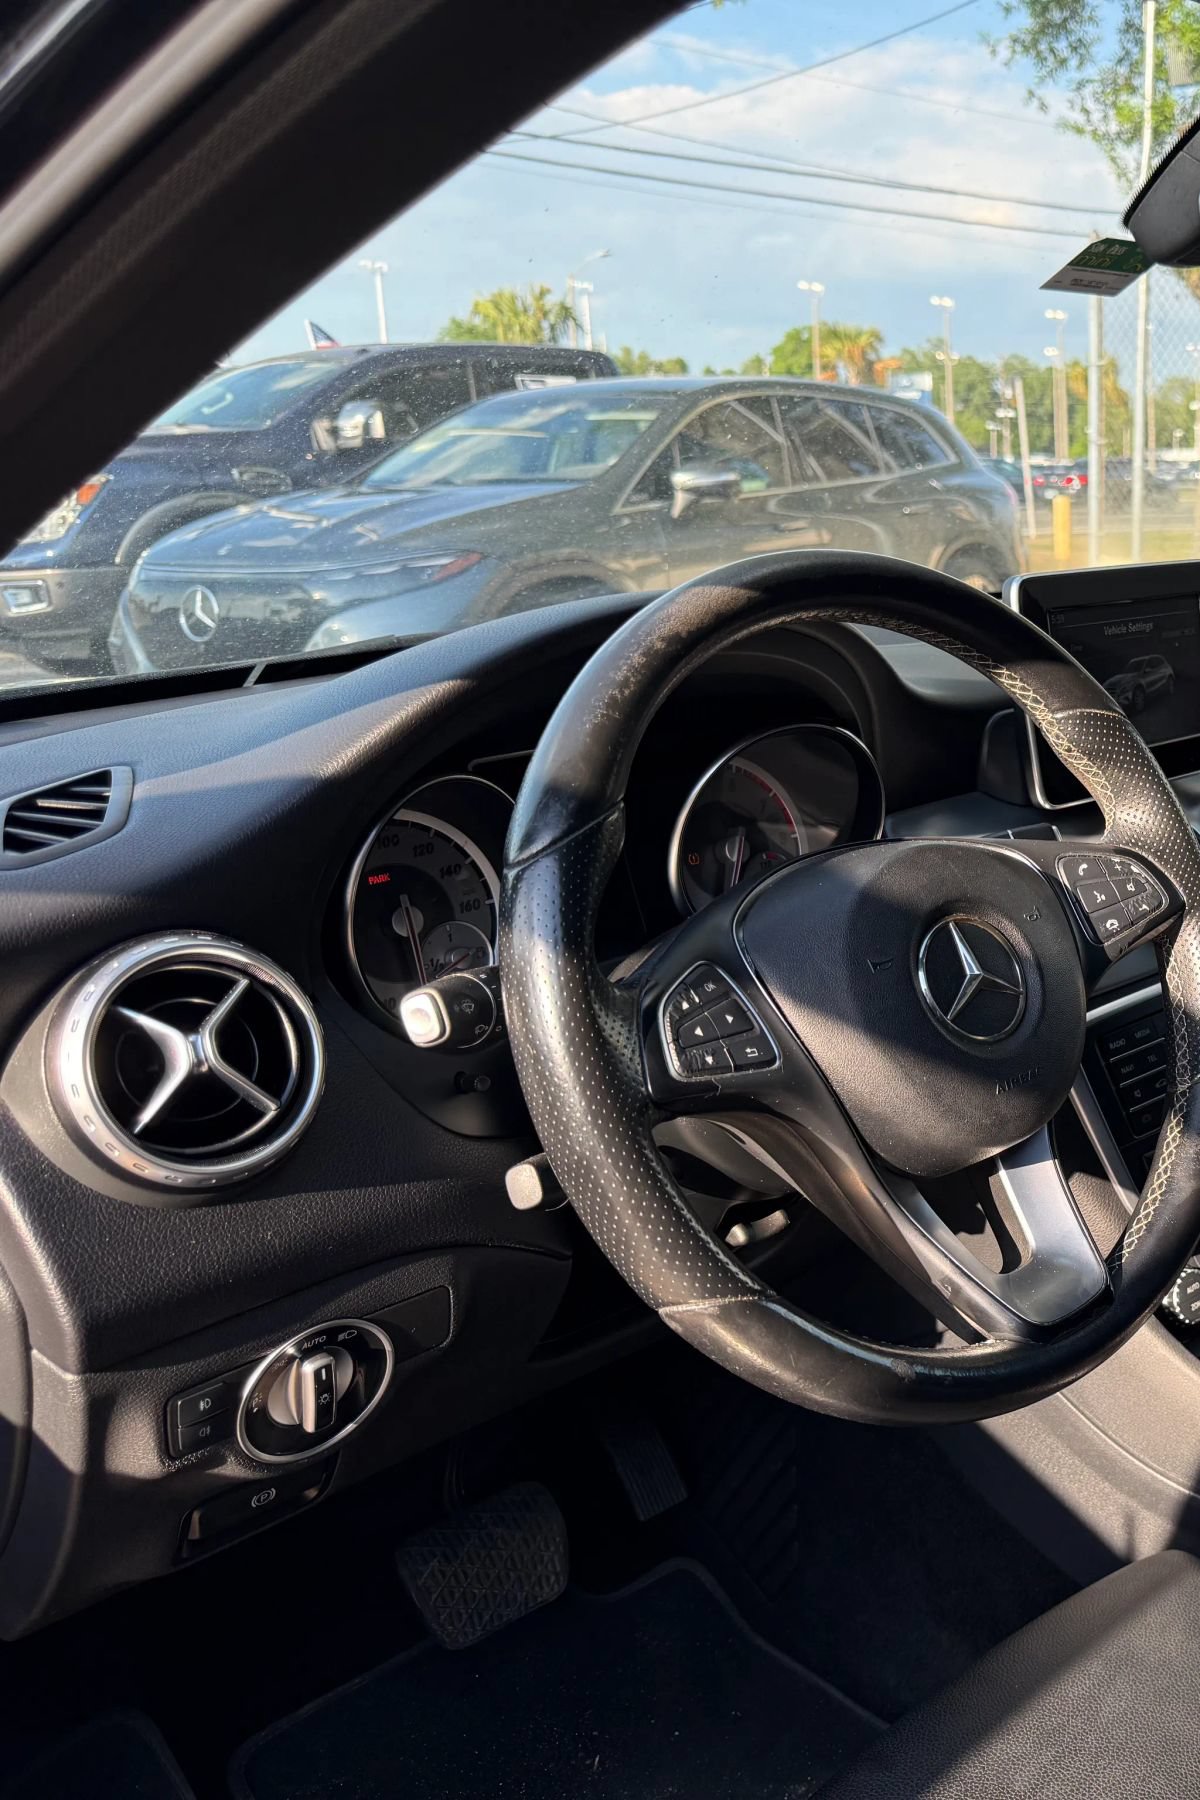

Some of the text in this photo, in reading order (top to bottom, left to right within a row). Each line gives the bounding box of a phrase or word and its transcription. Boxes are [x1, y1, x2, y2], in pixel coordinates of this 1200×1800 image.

[1104, 625, 1126, 636] Vehicle
[1128, 622, 1153, 633] Settings
[412, 842, 435, 858] 120
[440, 864, 461, 879] 140
[368, 873, 391, 885] PARK
[459, 899, 480, 914] 160
[703, 980, 717, 992] OK
[1109, 1037, 1127, 1050] RADIO
[302, 1335, 327, 1350] AUTO
